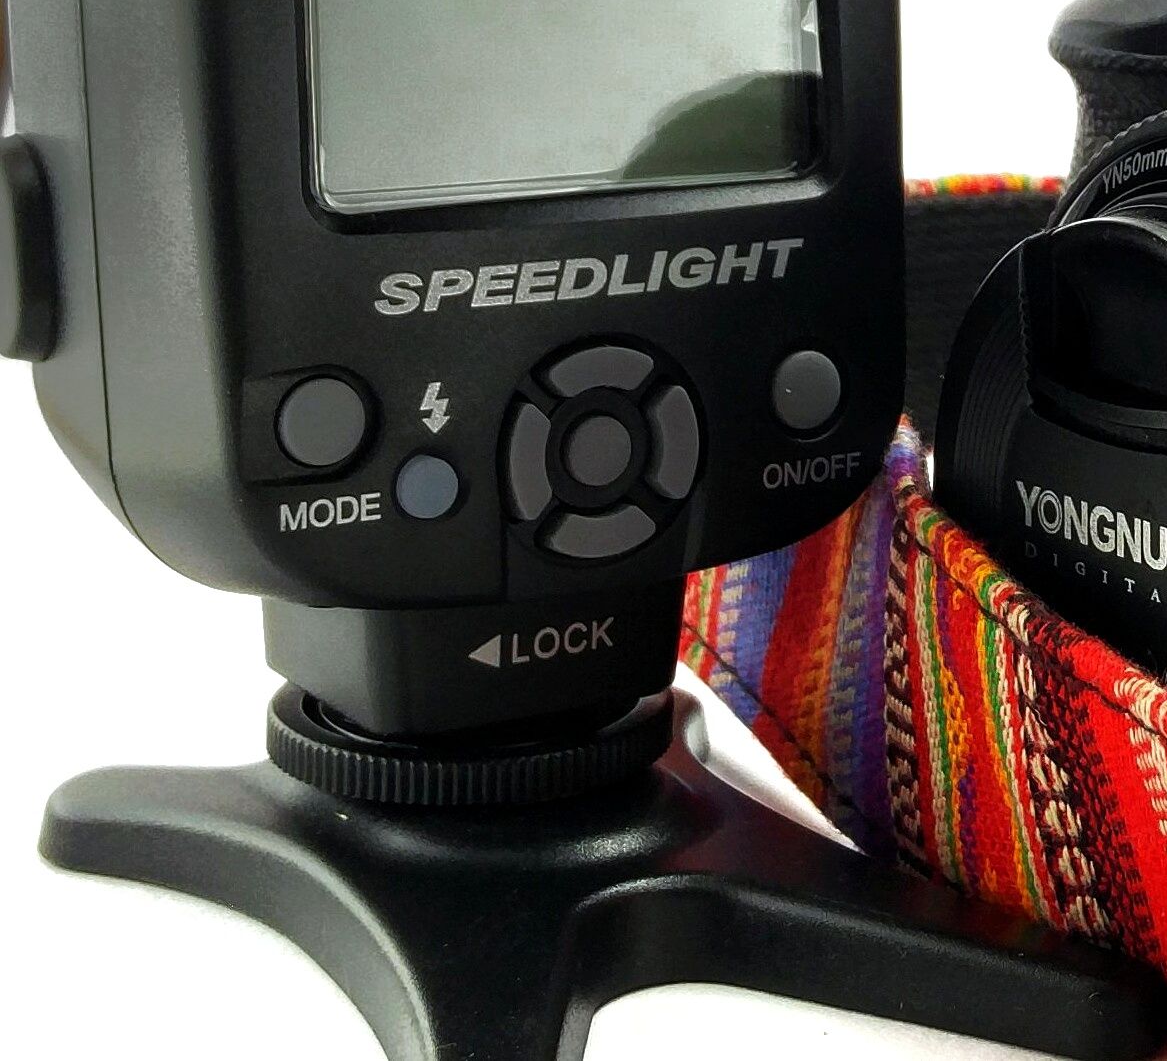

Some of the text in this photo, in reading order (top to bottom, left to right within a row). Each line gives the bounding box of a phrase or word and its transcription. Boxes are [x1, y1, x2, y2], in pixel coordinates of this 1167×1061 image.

[374, 238, 804, 316] SPEEDLIGHT
[762, 451, 861, 489] ON/OFF
[279, 491, 382, 532] MODE
[511, 617, 614, 664] LOCK
